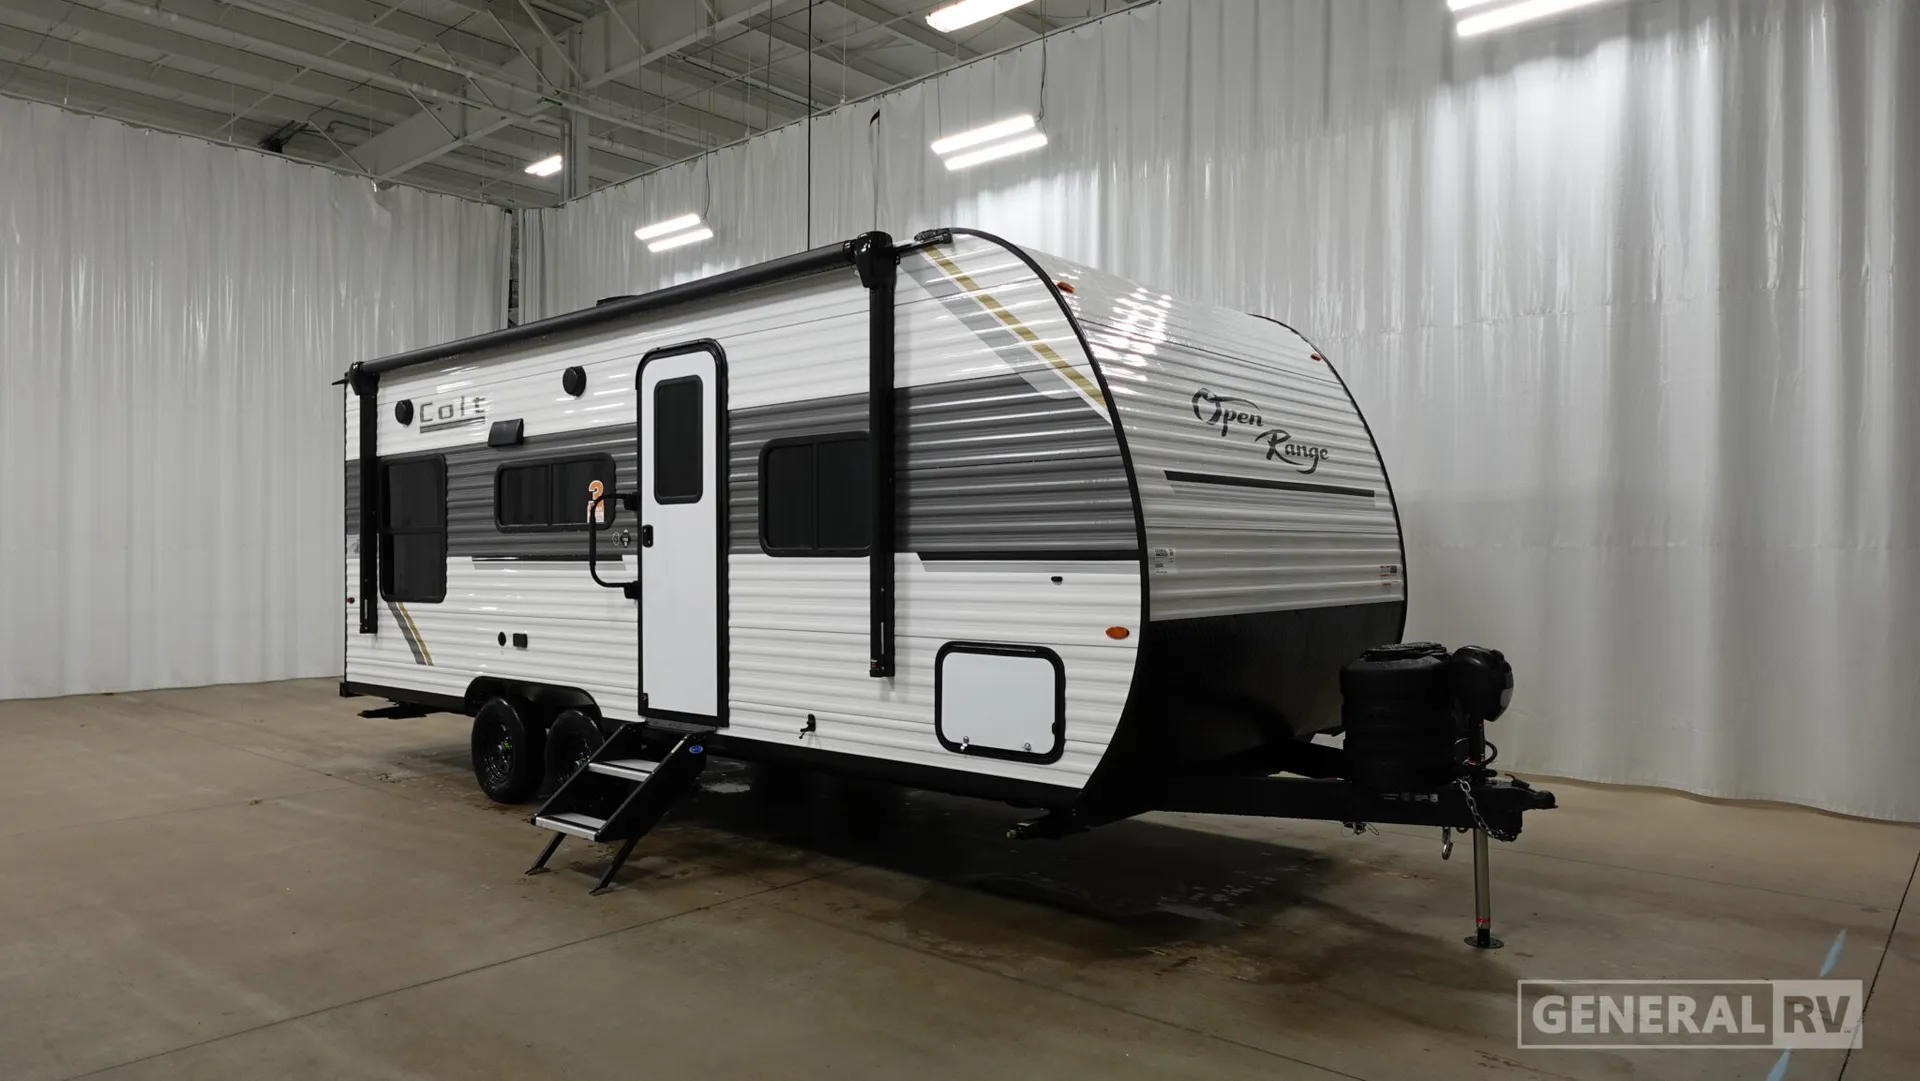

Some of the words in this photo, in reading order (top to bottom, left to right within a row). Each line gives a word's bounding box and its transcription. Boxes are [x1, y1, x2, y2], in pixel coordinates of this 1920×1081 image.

[420, 395, 486, 423] Colt
[1192, 388, 1263, 437] Open
[1254, 429, 1331, 475] Range
